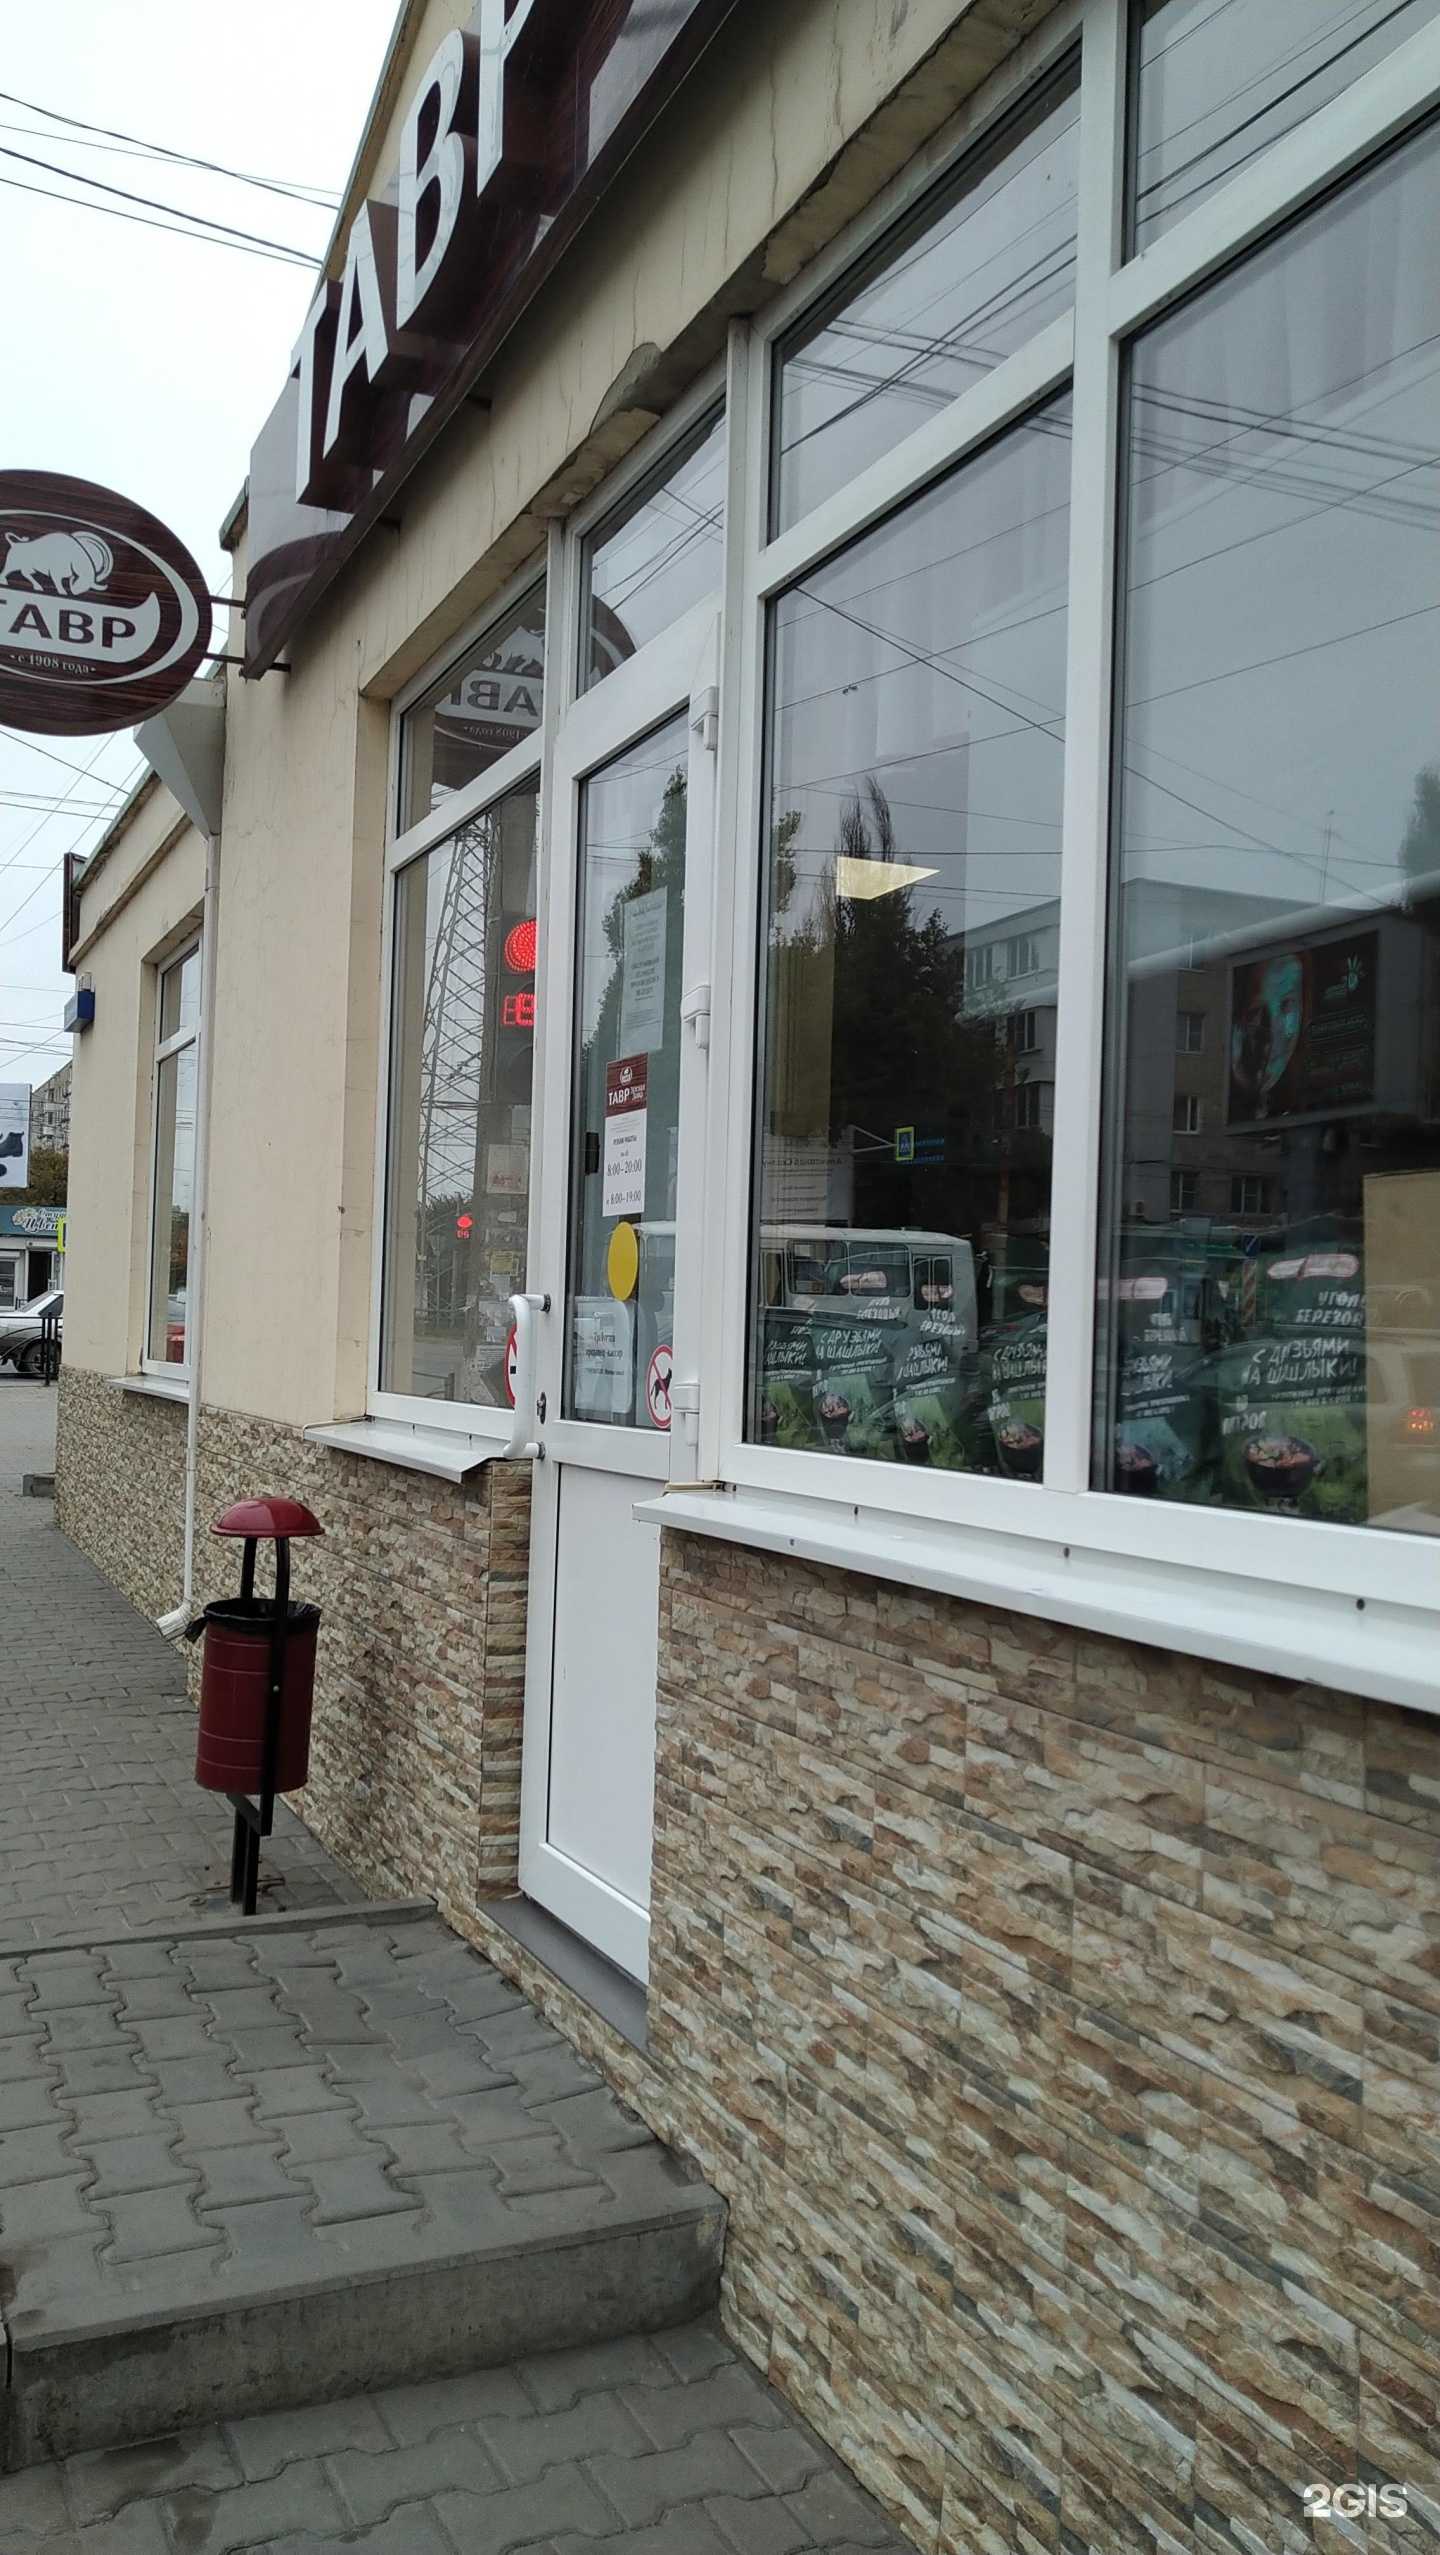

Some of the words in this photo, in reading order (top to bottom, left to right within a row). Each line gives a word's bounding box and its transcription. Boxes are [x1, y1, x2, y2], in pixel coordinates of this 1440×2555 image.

[291, 0, 534, 504] ТАВР
[29, 653, 59, 669] 1908
[62, 662, 89, 676] года
[608, 1087, 630, 1106] ТАВР
[1252, 1348, 1266, 1363] С
